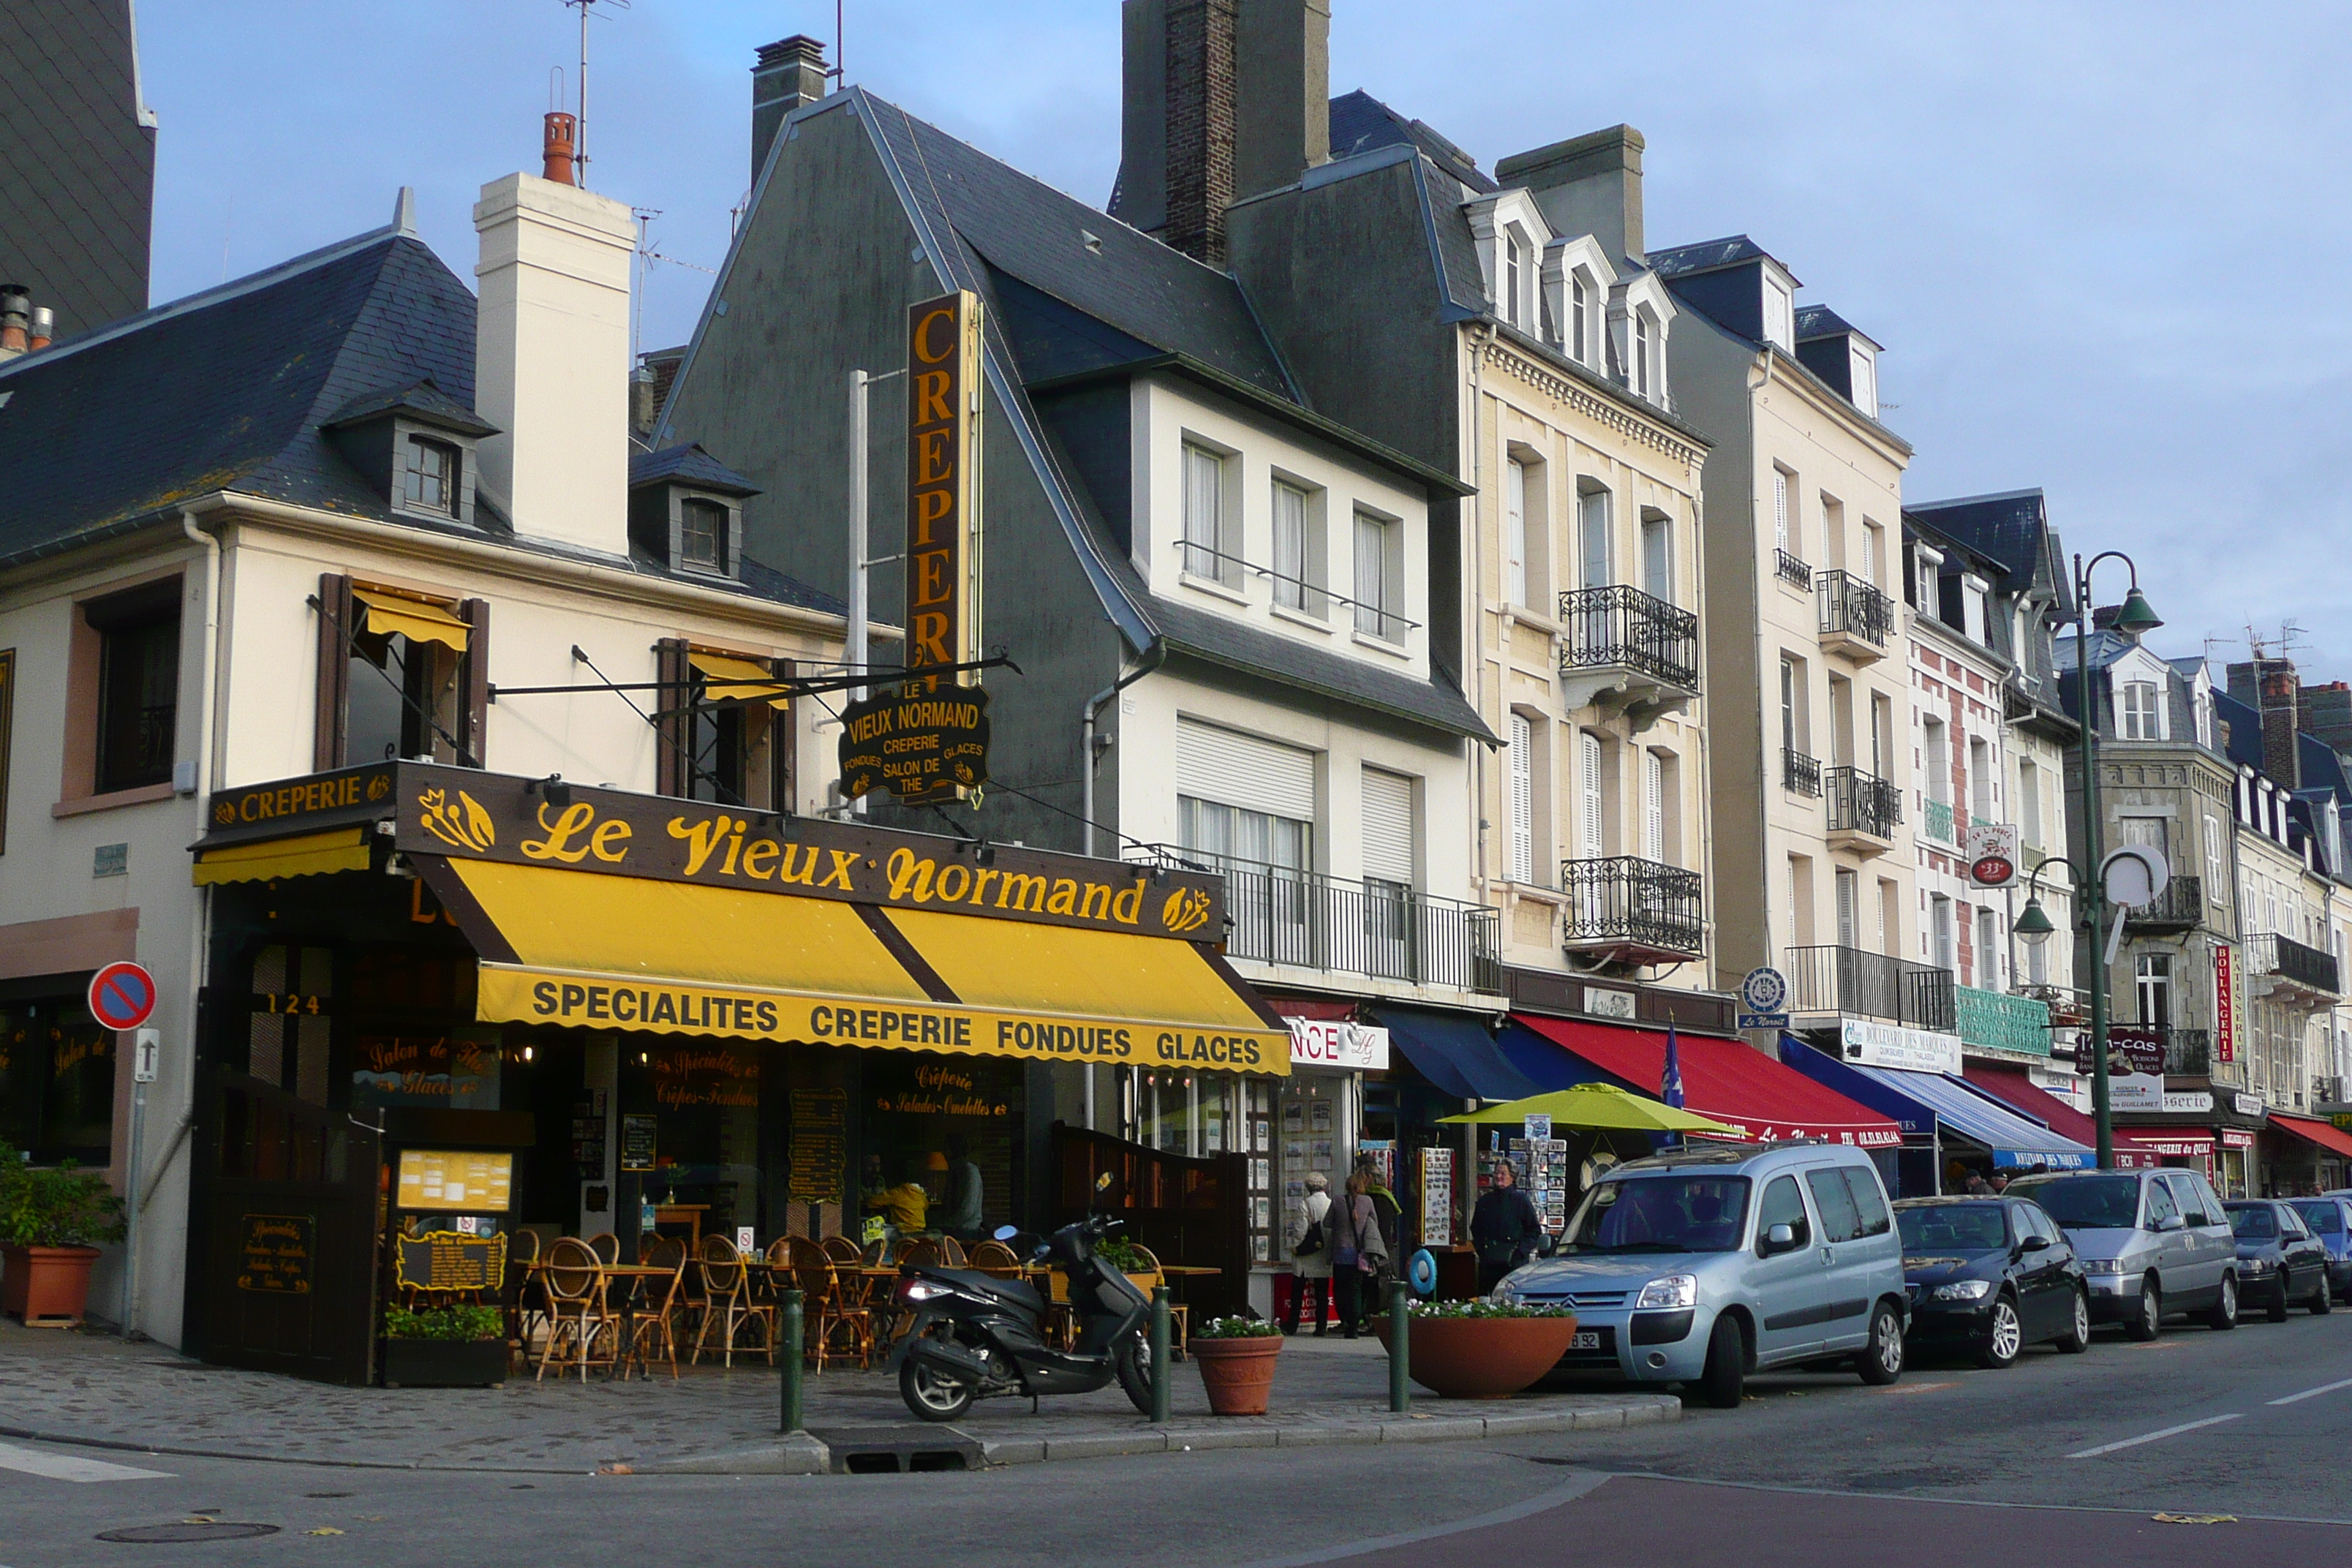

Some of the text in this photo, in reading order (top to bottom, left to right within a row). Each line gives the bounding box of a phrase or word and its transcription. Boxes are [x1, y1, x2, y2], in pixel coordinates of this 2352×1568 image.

[914, 306, 956, 693] CREPER
[904, 684, 920, 699] LE
[849, 701, 979, 745] VIEUX NORMAND
[883, 734, 940, 754] CREPERIE
[943, 742, 984, 760] GLACES
[844, 755, 882, 772] FONDUES
[883, 758, 940, 778] SALON DE
[900, 777, 922, 793] THE
[240, 774, 361, 823] CREPERIE
[521, 800, 1147, 926] Le Vieux Normand
[2219, 949, 2230, 1060] BOULANGERIE
[2234, 954, 2243, 1053] PATISSERIE
[532, 981, 1261, 1065] SPECIALITES CREPERIE FONDUES GLACES
[1743, 1017, 1754, 1027] Le
[429, 1036, 448, 1059] de
[1905, 1032, 1917, 1049] DES
[1919, 1034, 1948, 1054] MARQUES
[915, 1064, 973, 1092] Crêperie
[2183, 1144, 2192, 1153] du
[2193, 1143, 2210, 1156] QUAI
[1582, 1334, 1596, 1347] 92
